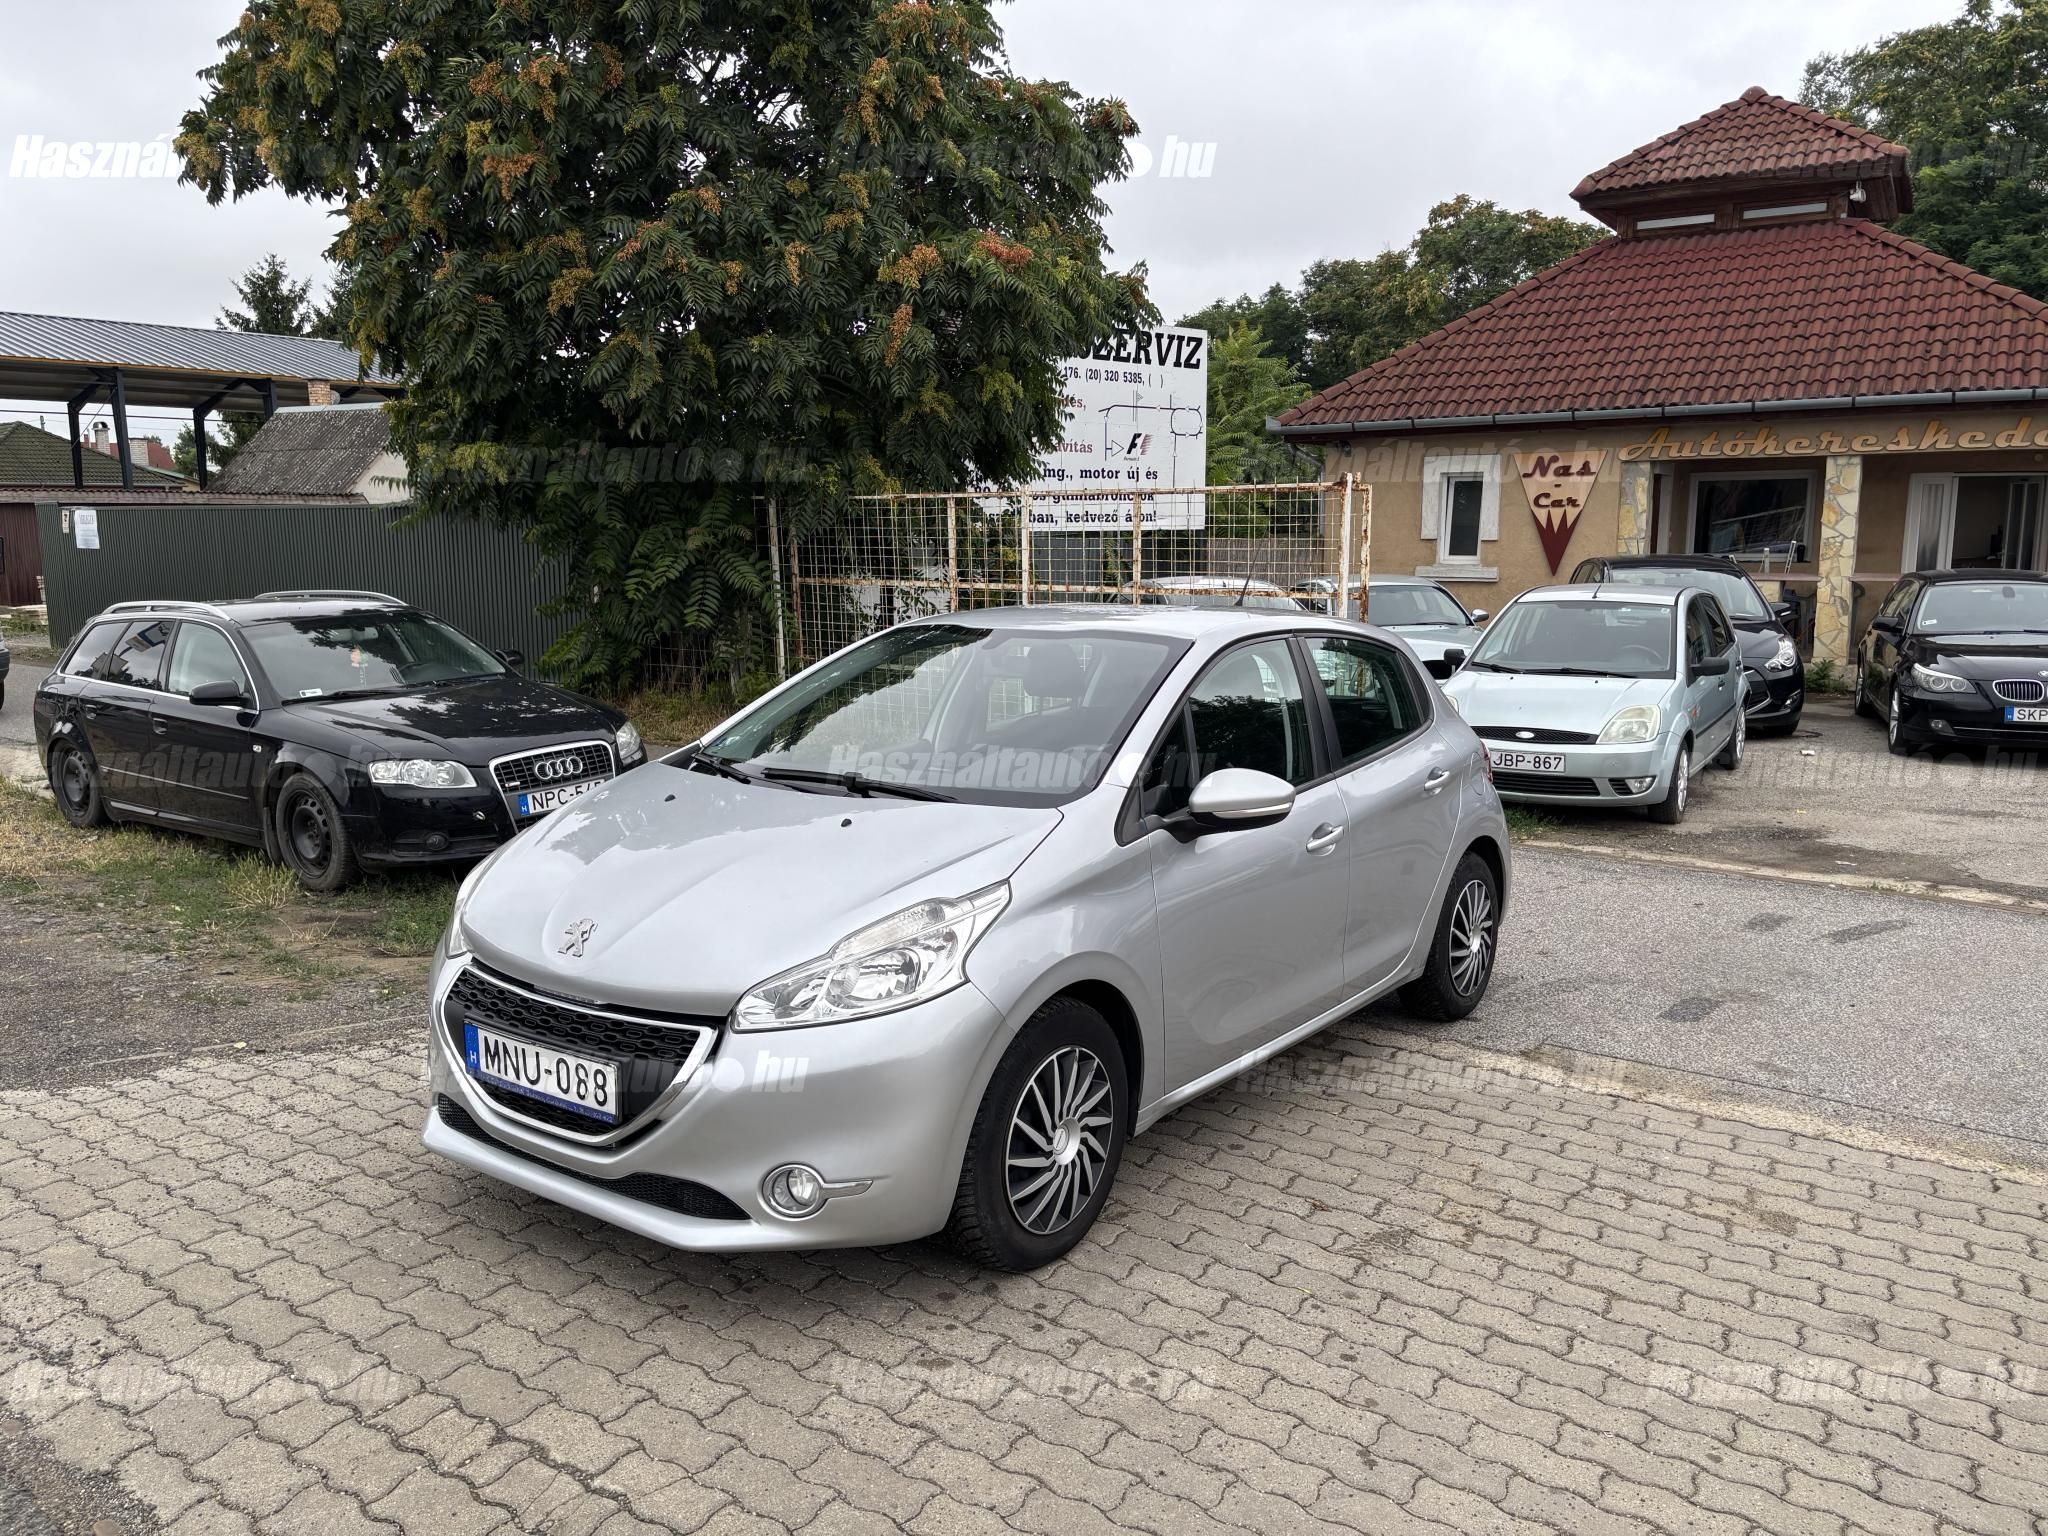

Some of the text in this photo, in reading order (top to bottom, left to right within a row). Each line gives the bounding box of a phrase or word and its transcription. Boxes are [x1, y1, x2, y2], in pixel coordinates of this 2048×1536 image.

[1085, 367, 1101, 383] (20)
[1104, 369, 1119, 382] 320
[1079, 468, 1121, 479] motor
[1127, 466, 1140, 482] új
[1145, 467, 1158, 480] és
[1522, 455, 1596, 478] Nas
[1533, 492, 1581, 508] Car
[1066, 508, 1118, 523] kedvező
[1125, 509, 1157, 523] áon!
[1493, 753, 1562, 770] JBP-867
[532, 781, 602, 812] NPC-5
[484, 1035, 608, 1107] MNU-088
